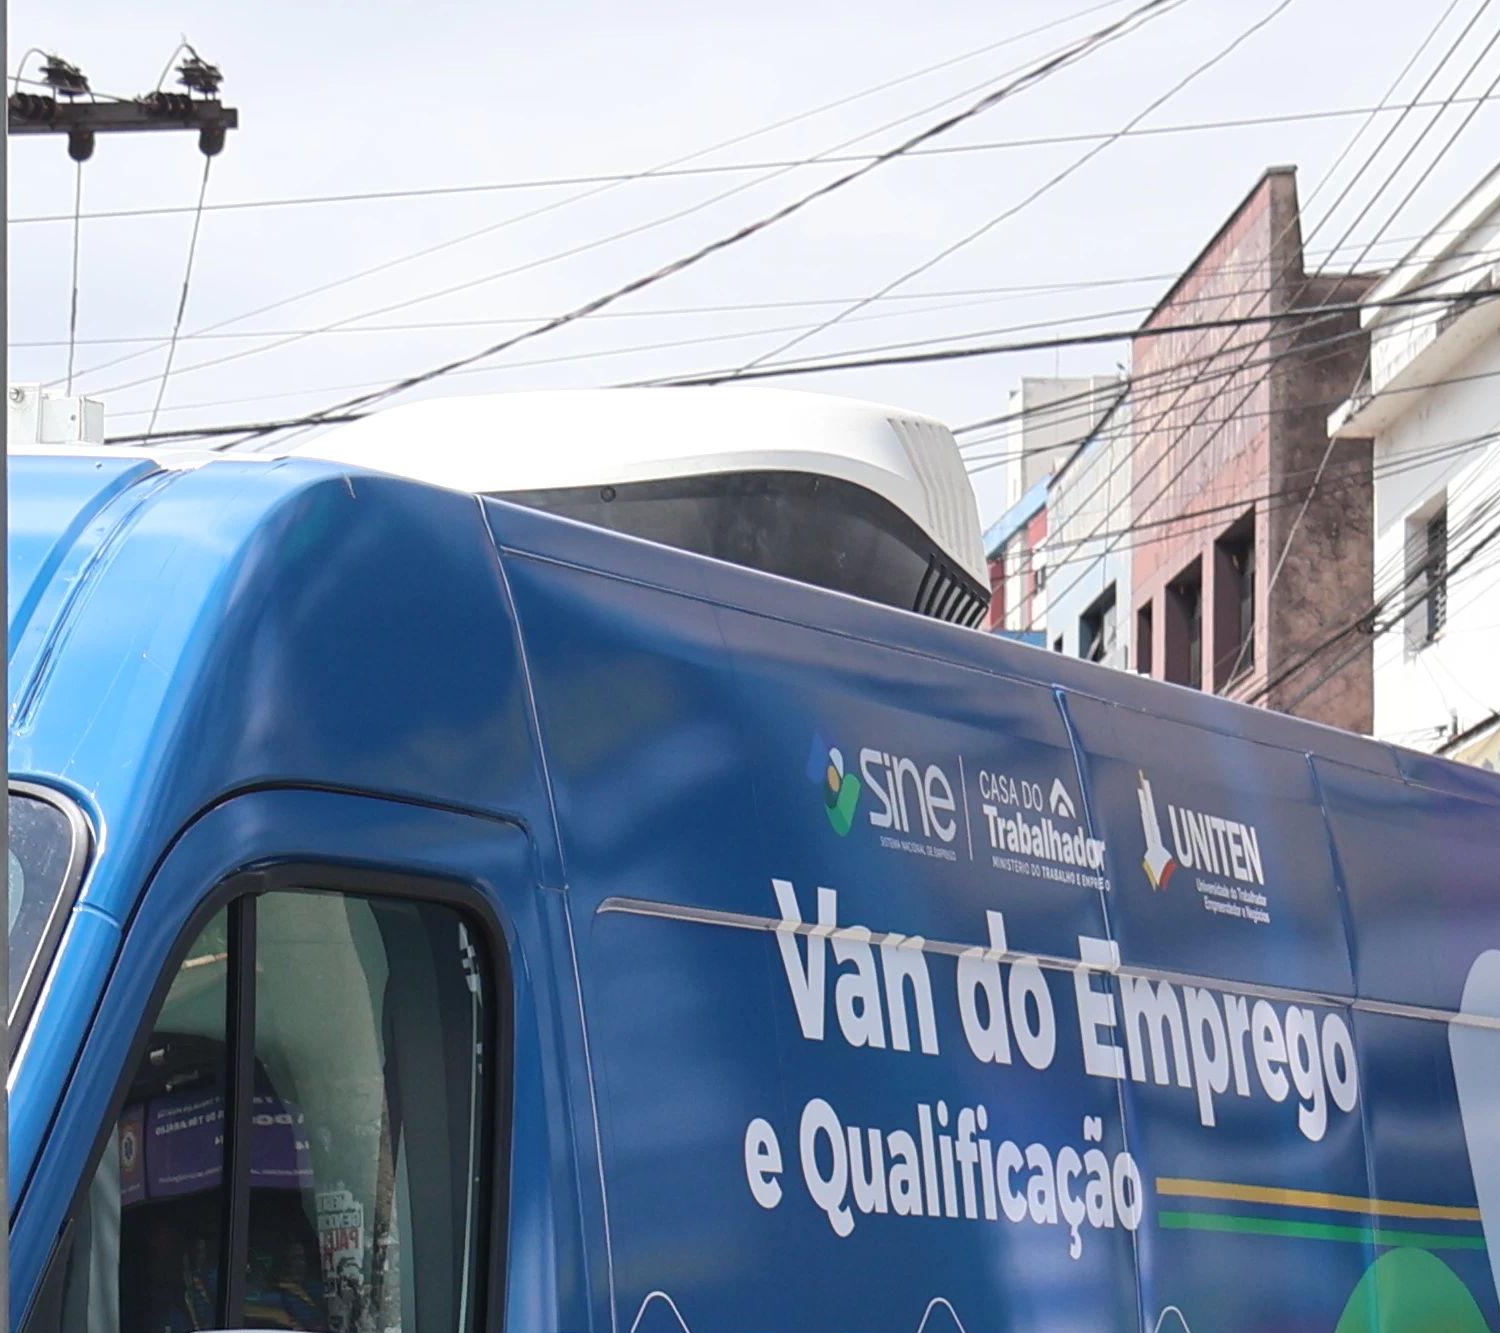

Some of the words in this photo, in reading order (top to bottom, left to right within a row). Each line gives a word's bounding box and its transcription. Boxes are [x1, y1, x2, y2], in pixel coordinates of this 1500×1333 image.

[859, 747, 956, 843] sine
[979, 770, 1019, 808] CASA
[1022, 781, 1043, 812] DO
[982, 804, 1106, 871] Trabalhador
[1031, 863, 1041, 878] DO
[1042, 865, 1075, 885] TRABALHO
[1082, 873, 1111, 891] EMPREO
[1168, 805, 1265, 885] UNITEN
[772, 878, 939, 1056] Van
[956, 909, 1056, 1070] do
[1077, 936, 1359, 1143] Emprego
[743, 1117, 783, 1209] e
[799, 1095, 1143, 1259] Qualificação
